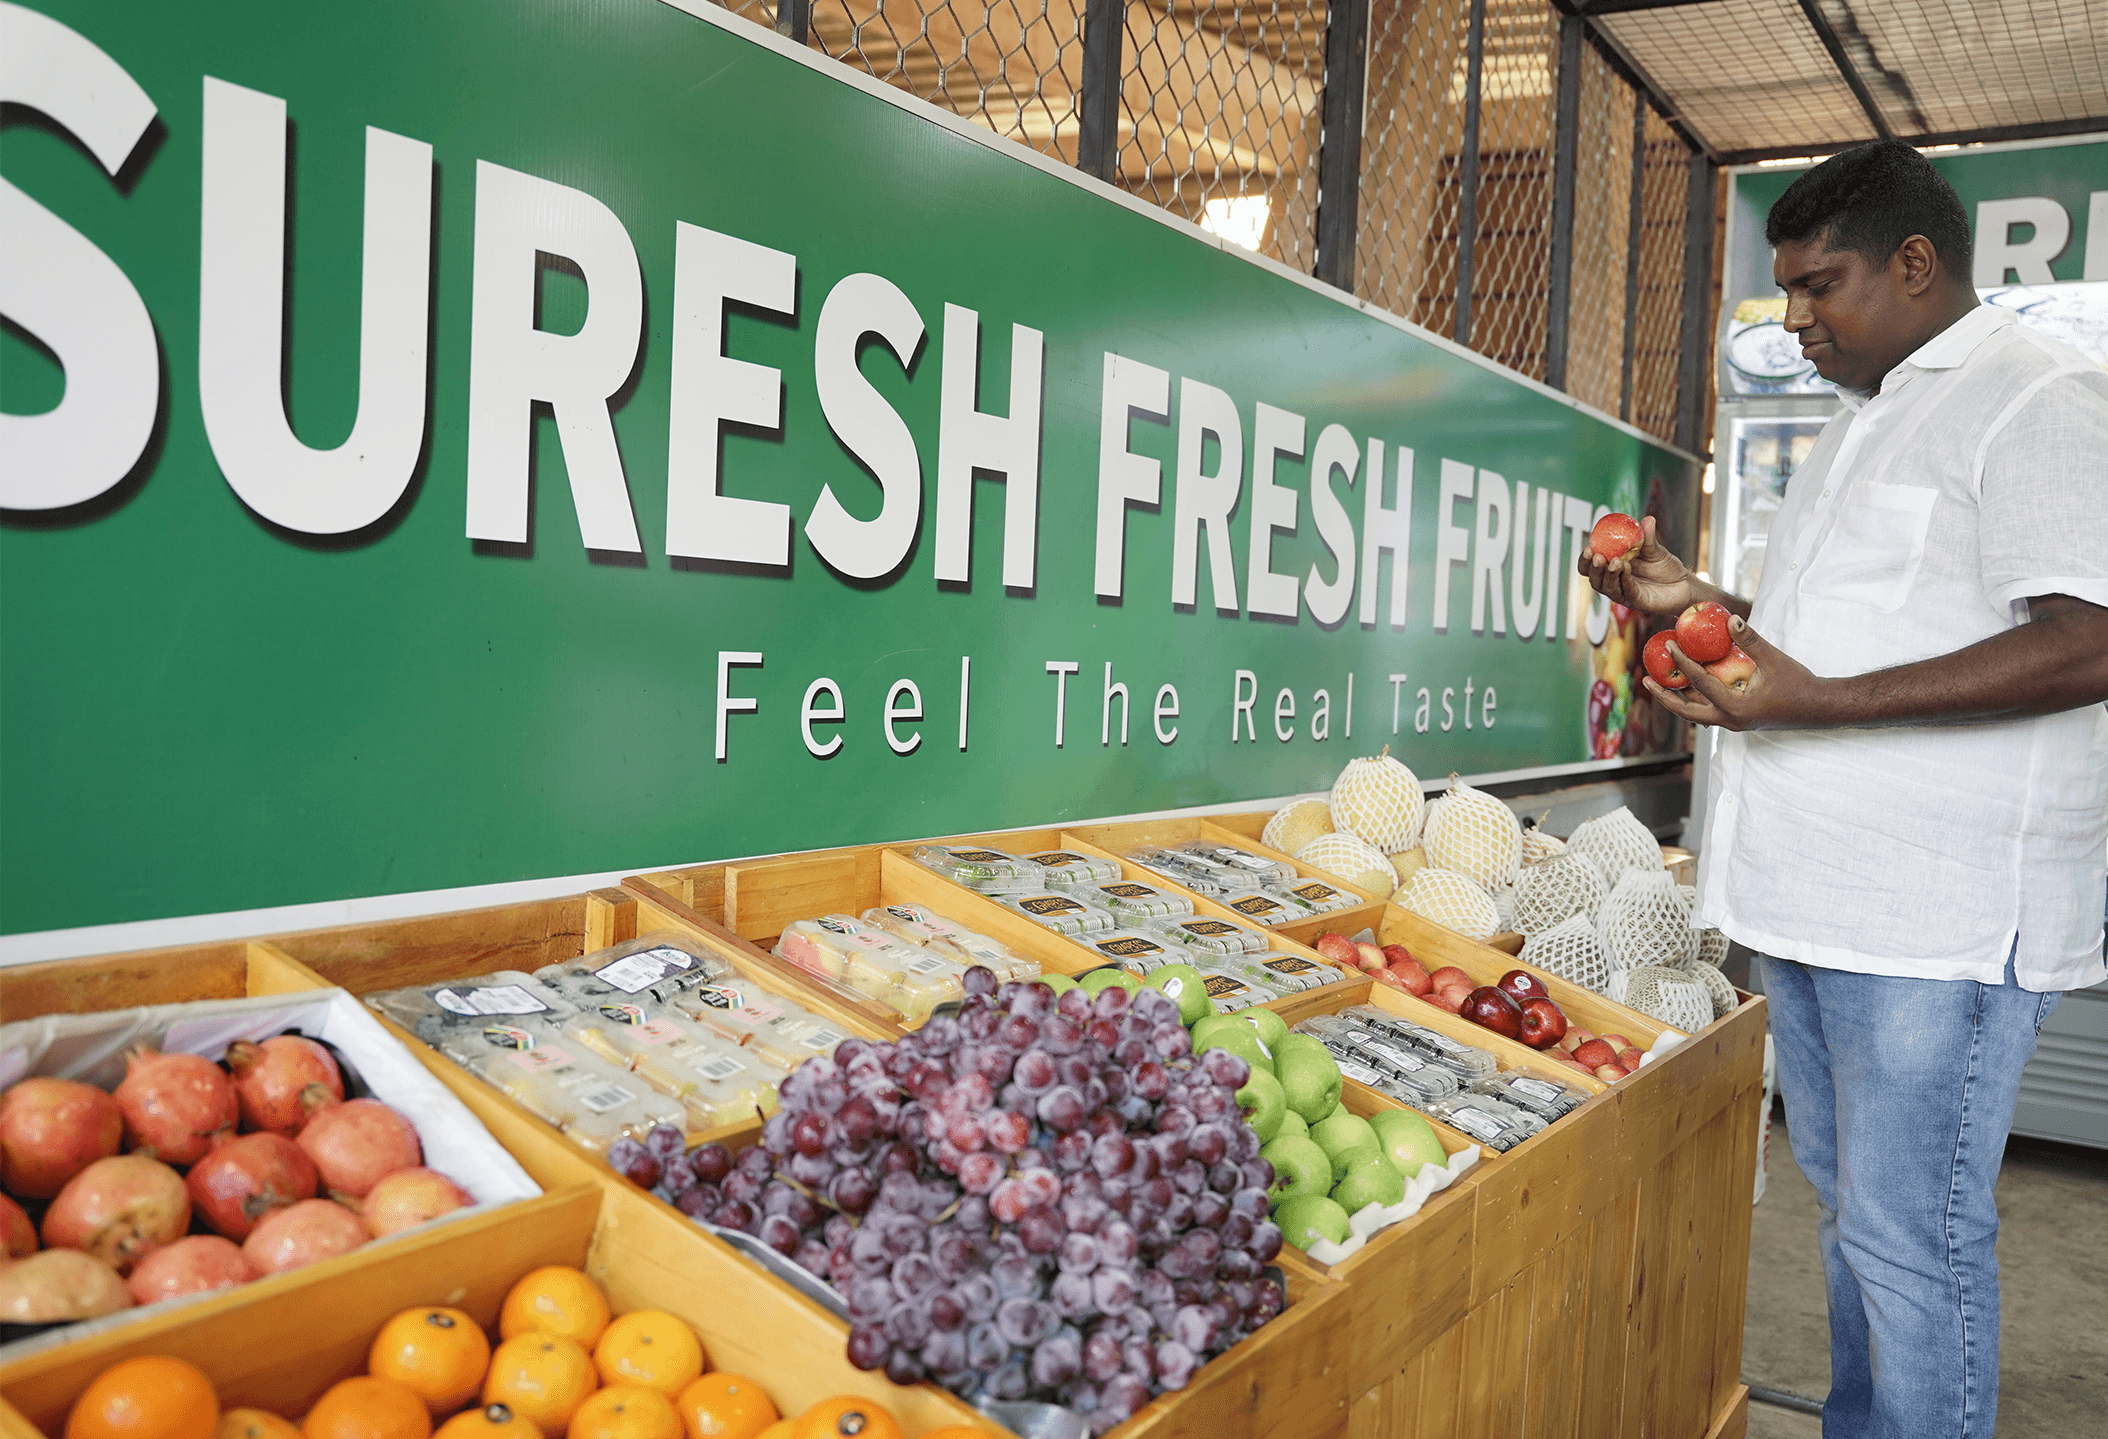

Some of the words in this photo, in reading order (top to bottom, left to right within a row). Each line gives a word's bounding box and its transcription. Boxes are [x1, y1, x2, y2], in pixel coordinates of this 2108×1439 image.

[1094, 351, 1414, 627] FRESH
[715, 651, 969, 759] Feel
[1046, 661, 1180, 746] The
[1232, 669, 1353, 741] Real
[1389, 674, 1497, 735] Taste
